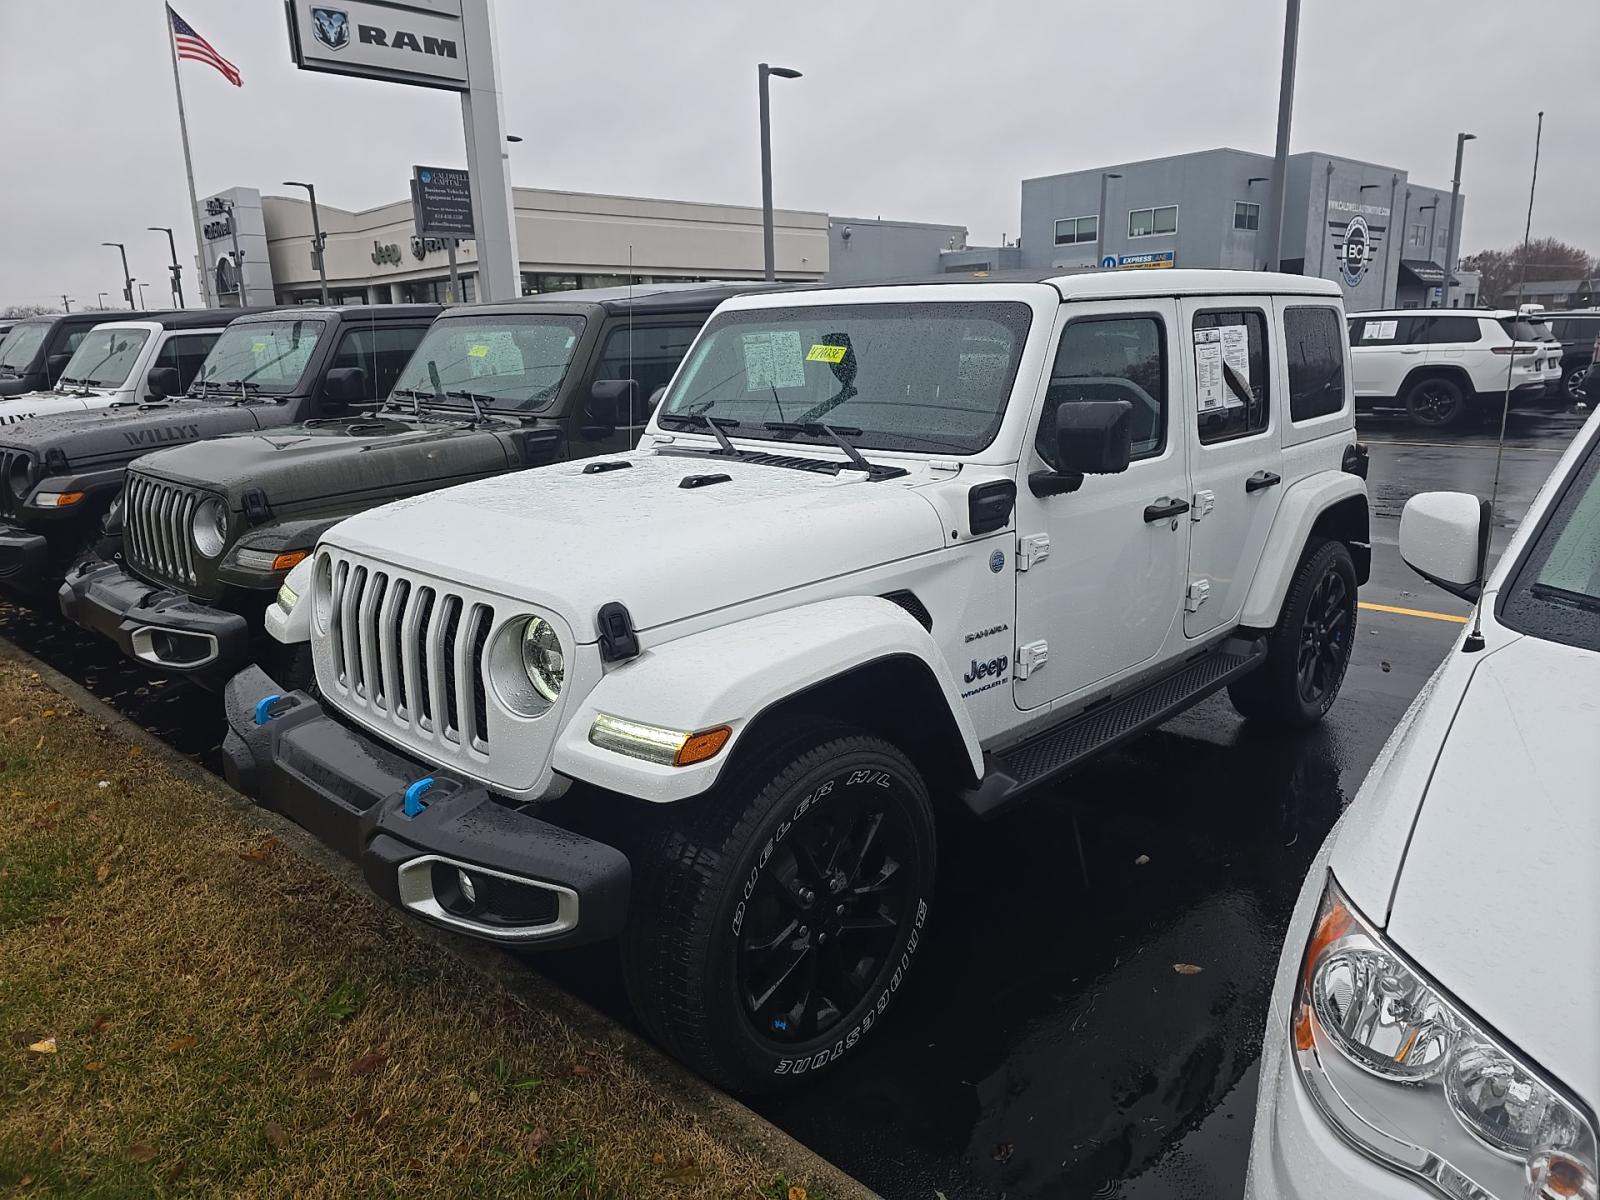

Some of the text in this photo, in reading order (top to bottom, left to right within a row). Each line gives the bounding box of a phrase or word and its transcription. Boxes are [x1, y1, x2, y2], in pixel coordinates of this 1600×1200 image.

[357, 24, 457, 59] RAM
[371, 240, 402, 267] Jeep
[1122, 255, 1152, 264] EXPRESS
[1348, 244, 1363, 259] BC
[122, 424, 200, 446] WILLYS
[964, 624, 1009, 643] SAHARA
[964, 655, 1009, 684] Jeep
[961, 680, 1002, 699] WRANGLER
[732, 780, 835, 936] DUELER
[773, 898, 929, 1075] BRIDGESTONE
